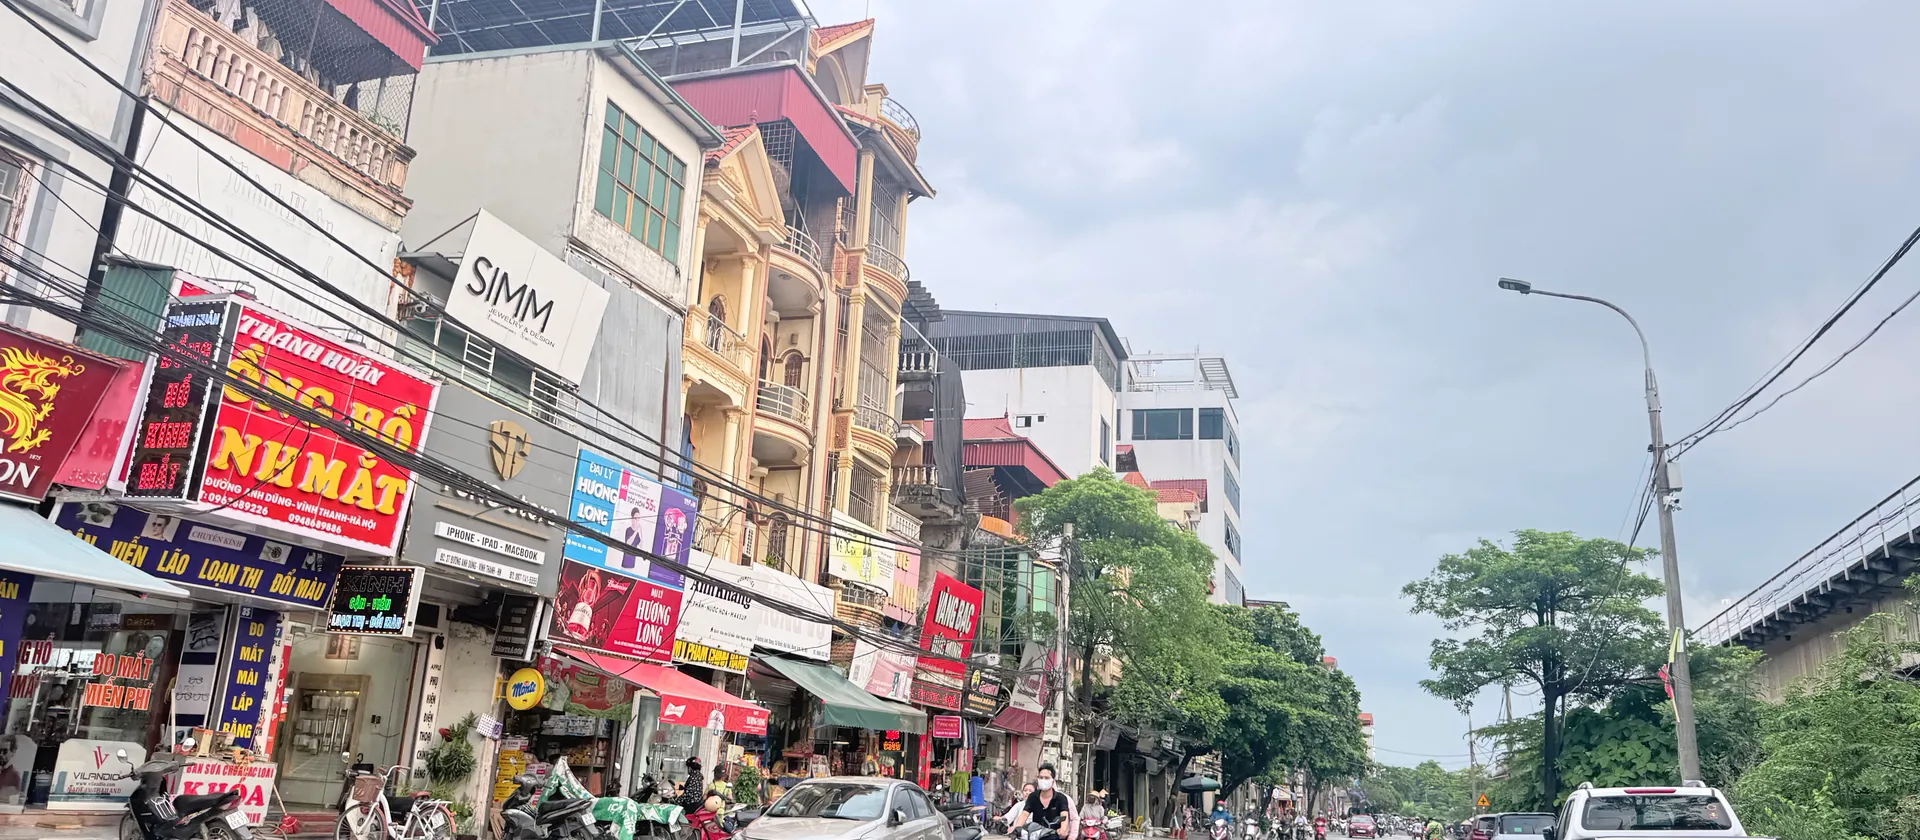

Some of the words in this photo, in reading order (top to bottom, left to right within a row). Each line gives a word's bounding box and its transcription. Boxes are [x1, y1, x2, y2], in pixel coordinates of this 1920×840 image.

[467, 256, 555, 333] SIMM
[488, 307, 524, 330] JEWELRY
[530, 330, 556, 348] DESIGN
[238, 315, 323, 363] THÀNH
[320, 354, 386, 386] HUÂN
[297, 449, 407, 516] MẮT
[287, 512, 343, 535] 0948689886
[577, 503, 609, 526] LONG
[191, 530, 223, 546] CHUYÊN
[224, 534, 243, 548] KÍNH
[447, 527, 475, 543] IPHONE
[482, 536, 499, 549] IPAD
[505, 544, 538, 560] MACBOOK
[157, 548, 190, 576] LÃO
[198, 558, 242, 588] LOẠN
[241, 566, 263, 594] THỊ
[269, 569, 297, 595] ĐỔI
[297, 577, 327, 602] MÀU
[635, 599, 672, 626] HƯƠNG
[249, 622, 264, 637] ĐO
[635, 621, 664, 647] LONG
[92, 653, 115, 676] ĐO
[117, 648, 153, 680] MẮT
[240, 643, 264, 663] MẮT
[236, 668, 258, 686] MÀI
[84, 676, 124, 707] MIỄN
[124, 682, 154, 710] PHÍ
[231, 692, 253, 711] LẮP
[222, 718, 252, 739] BẰNG
[73, 772, 120, 781] VILANDIO
